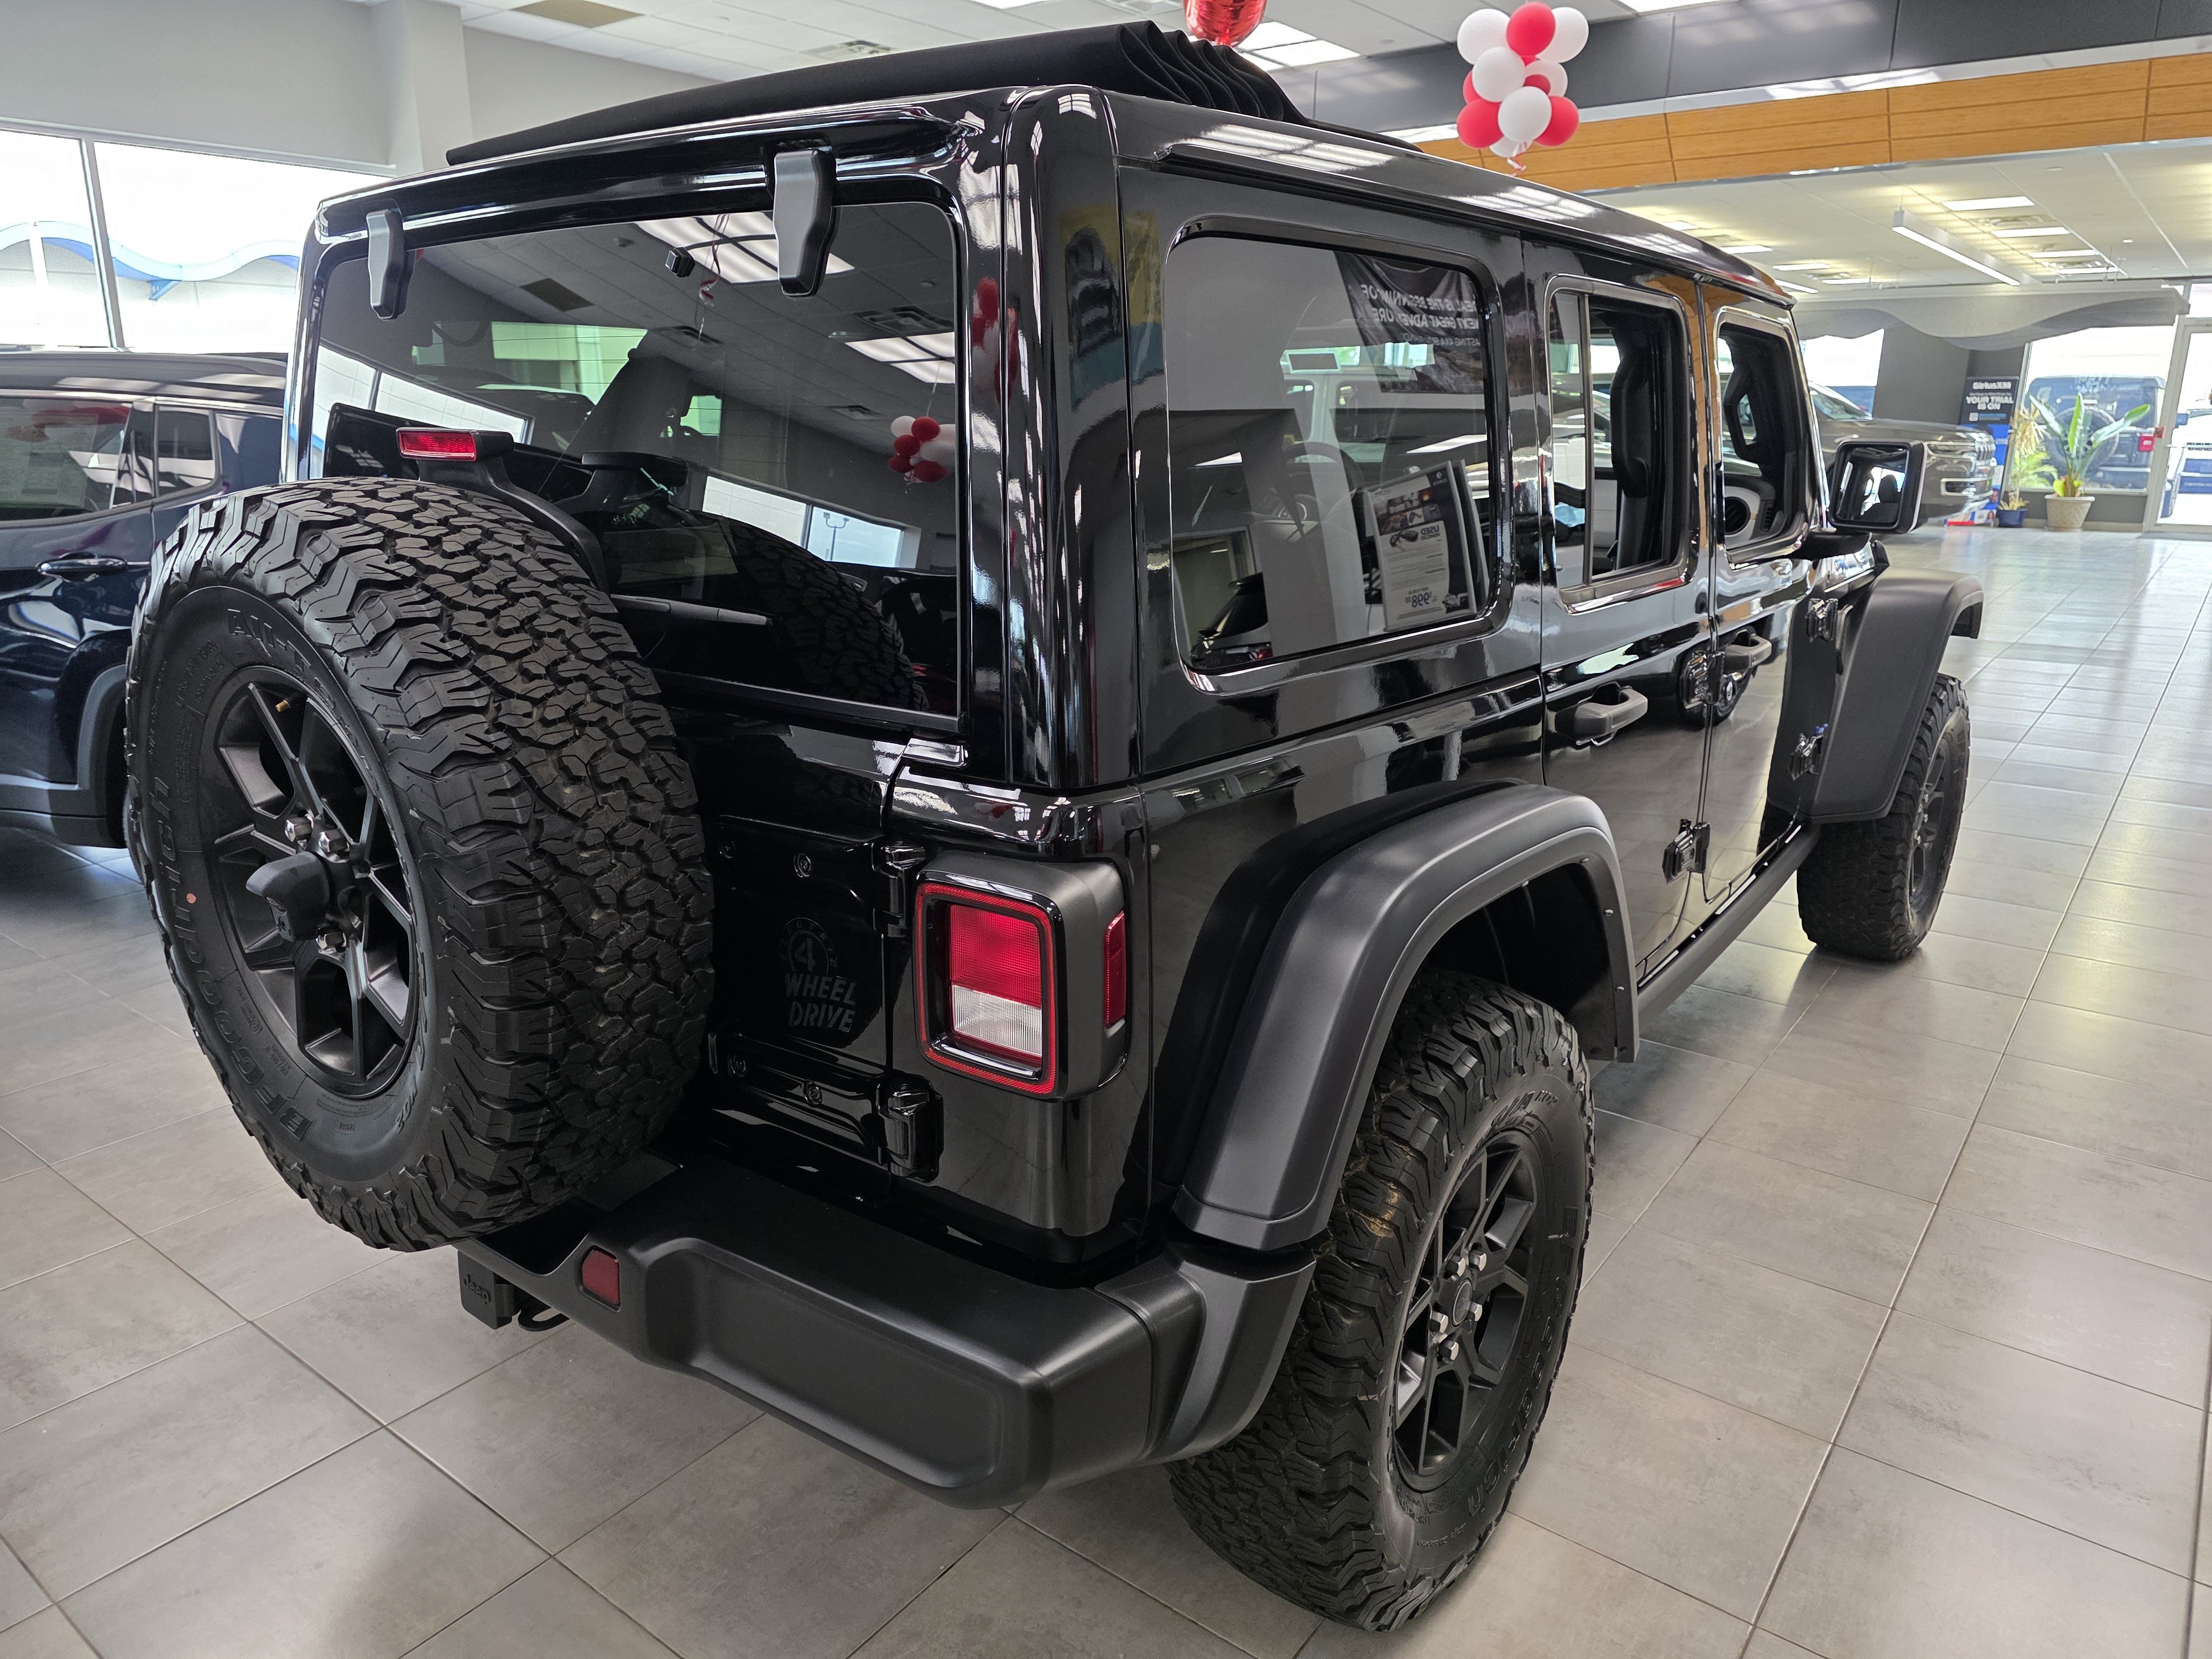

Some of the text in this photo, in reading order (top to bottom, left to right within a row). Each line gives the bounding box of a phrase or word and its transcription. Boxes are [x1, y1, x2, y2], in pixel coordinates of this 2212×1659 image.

[1966, 396, 1989, 404] YOUR
[794, 937, 816, 972] 4
[785, 972, 857, 1006] WHEEL
[789, 1001, 857, 1033] DRIVE
[462, 1274, 491, 1305] Jeep
